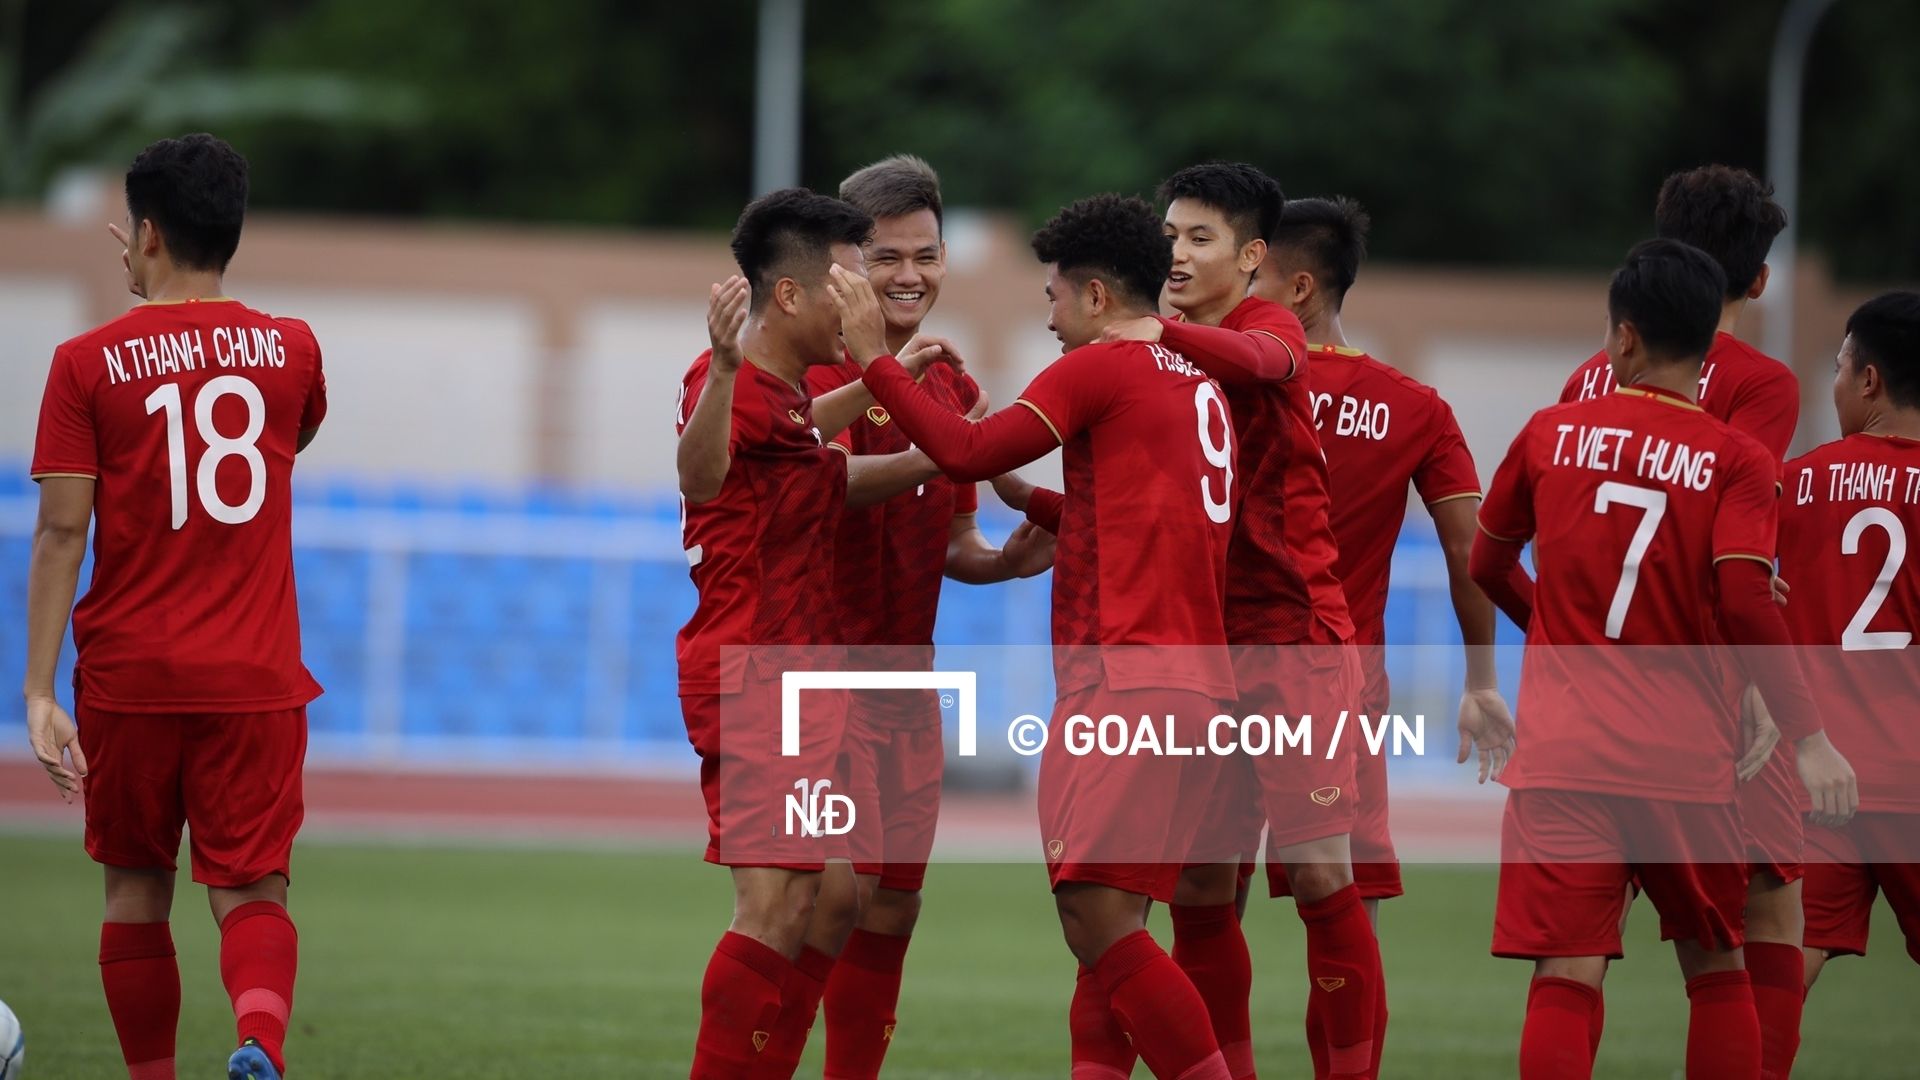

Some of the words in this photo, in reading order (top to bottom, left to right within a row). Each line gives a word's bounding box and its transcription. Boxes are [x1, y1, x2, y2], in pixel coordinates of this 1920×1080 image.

[103, 330, 206, 384] N.THANH
[212, 326, 285, 367] CHUNG
[145, 375, 266, 530] 18
[1194, 381, 1233, 524] 9
[1336, 395, 1390, 441] BAO
[1553, 424, 1632, 472] T.VIET
[1637, 435, 1716, 491] HUNG
[1797, 467, 1814, 506] D.
[1829, 462, 1897, 502] THANH
[1594, 480, 1667, 639] 7
[1841, 507, 1912, 651] 2
